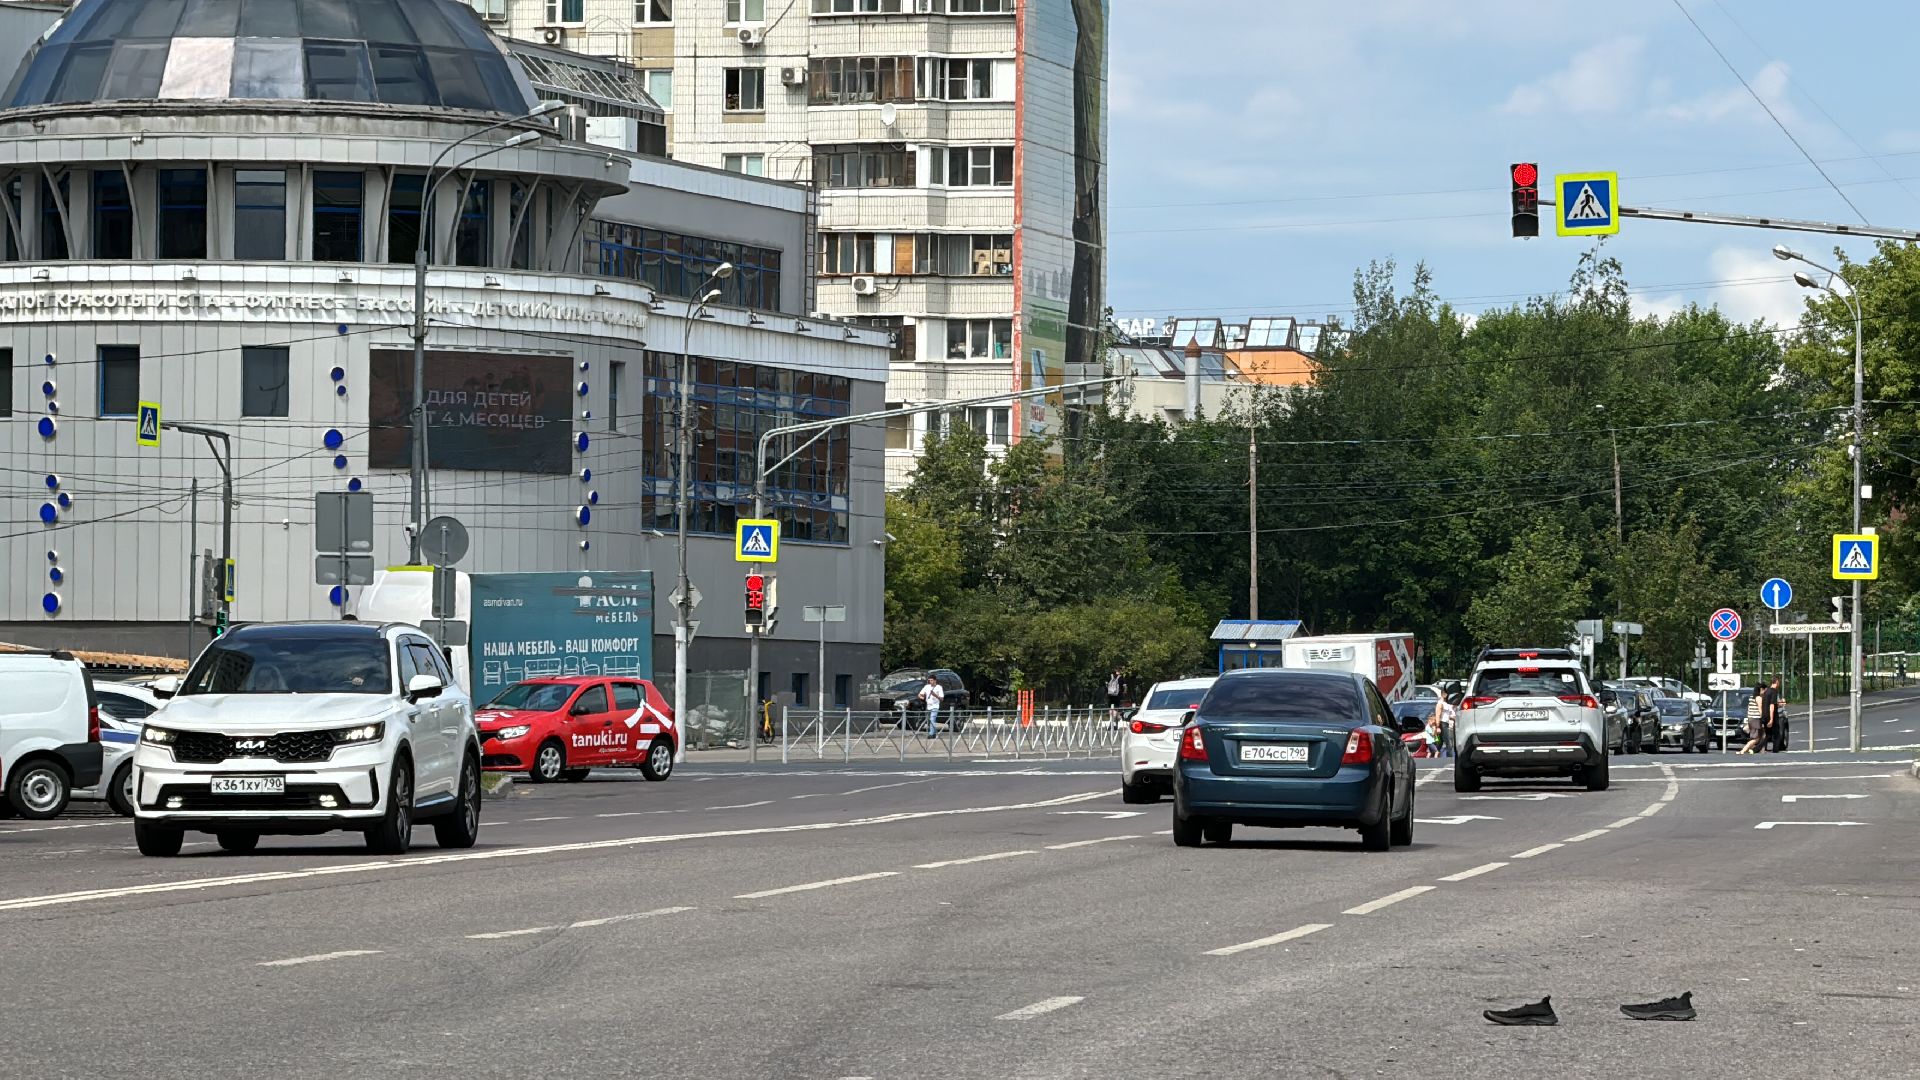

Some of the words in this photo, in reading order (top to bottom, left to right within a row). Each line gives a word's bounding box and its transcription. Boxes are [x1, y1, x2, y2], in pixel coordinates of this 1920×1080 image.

[54, 293, 147, 308] КРАСОТЫ
[246, 294, 335, 310] ФИТНЕС
[358, 294, 449, 314] БАССЙН
[426, 390, 467, 406] ДЛЯ
[473, 391, 532, 409] ДЕТЕЙ
[441, 411, 454, 427] 4
[459, 412, 545, 430] МЕСЯЦЕВ
[595, 611, 639, 623] МЕБЕЛЬ
[483, 641, 515, 656] НАША
[517, 640, 557, 655] МЕБЕЛЬ
[565, 638, 589, 654] ВАШ
[591, 637, 639, 653] КОМФОРТ
[572, 730, 628, 747] tanuki.ru
[263, 778, 282, 788] 790
